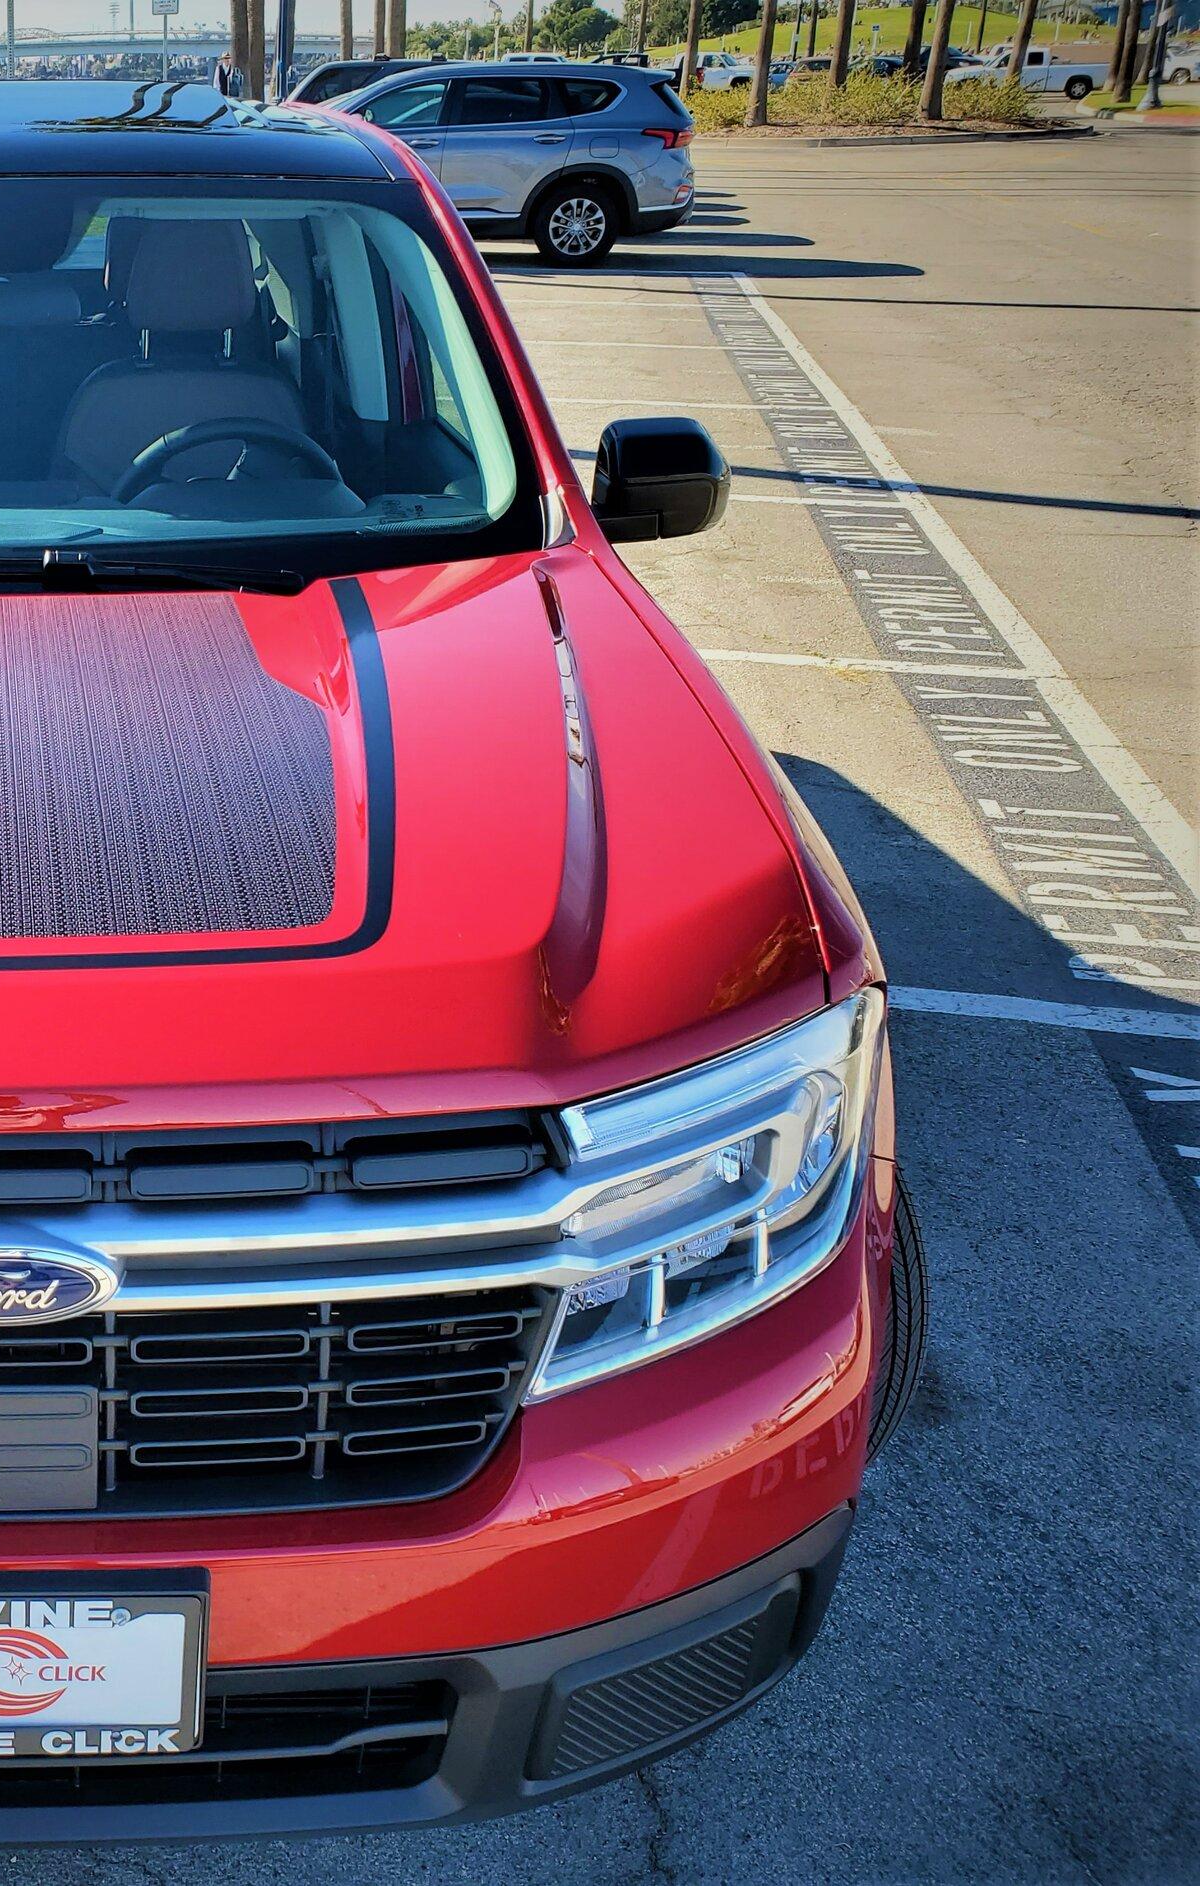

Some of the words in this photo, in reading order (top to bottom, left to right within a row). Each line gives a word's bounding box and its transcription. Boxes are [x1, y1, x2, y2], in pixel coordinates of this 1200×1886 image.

[747, 373, 825, 405] PERMIT
[767, 412, 849, 440] ONLY
[786, 446, 889, 498] PERMIT
[819, 508, 932, 556] ONLY
[853, 568, 1006, 658] PERMIT
[914, 685, 1084, 773] ONLY
[977, 798, 1200, 991] PERMIT
[38, 1664, 107, 1682] CLICK
[40, 1727, 181, 1756] CLICK
